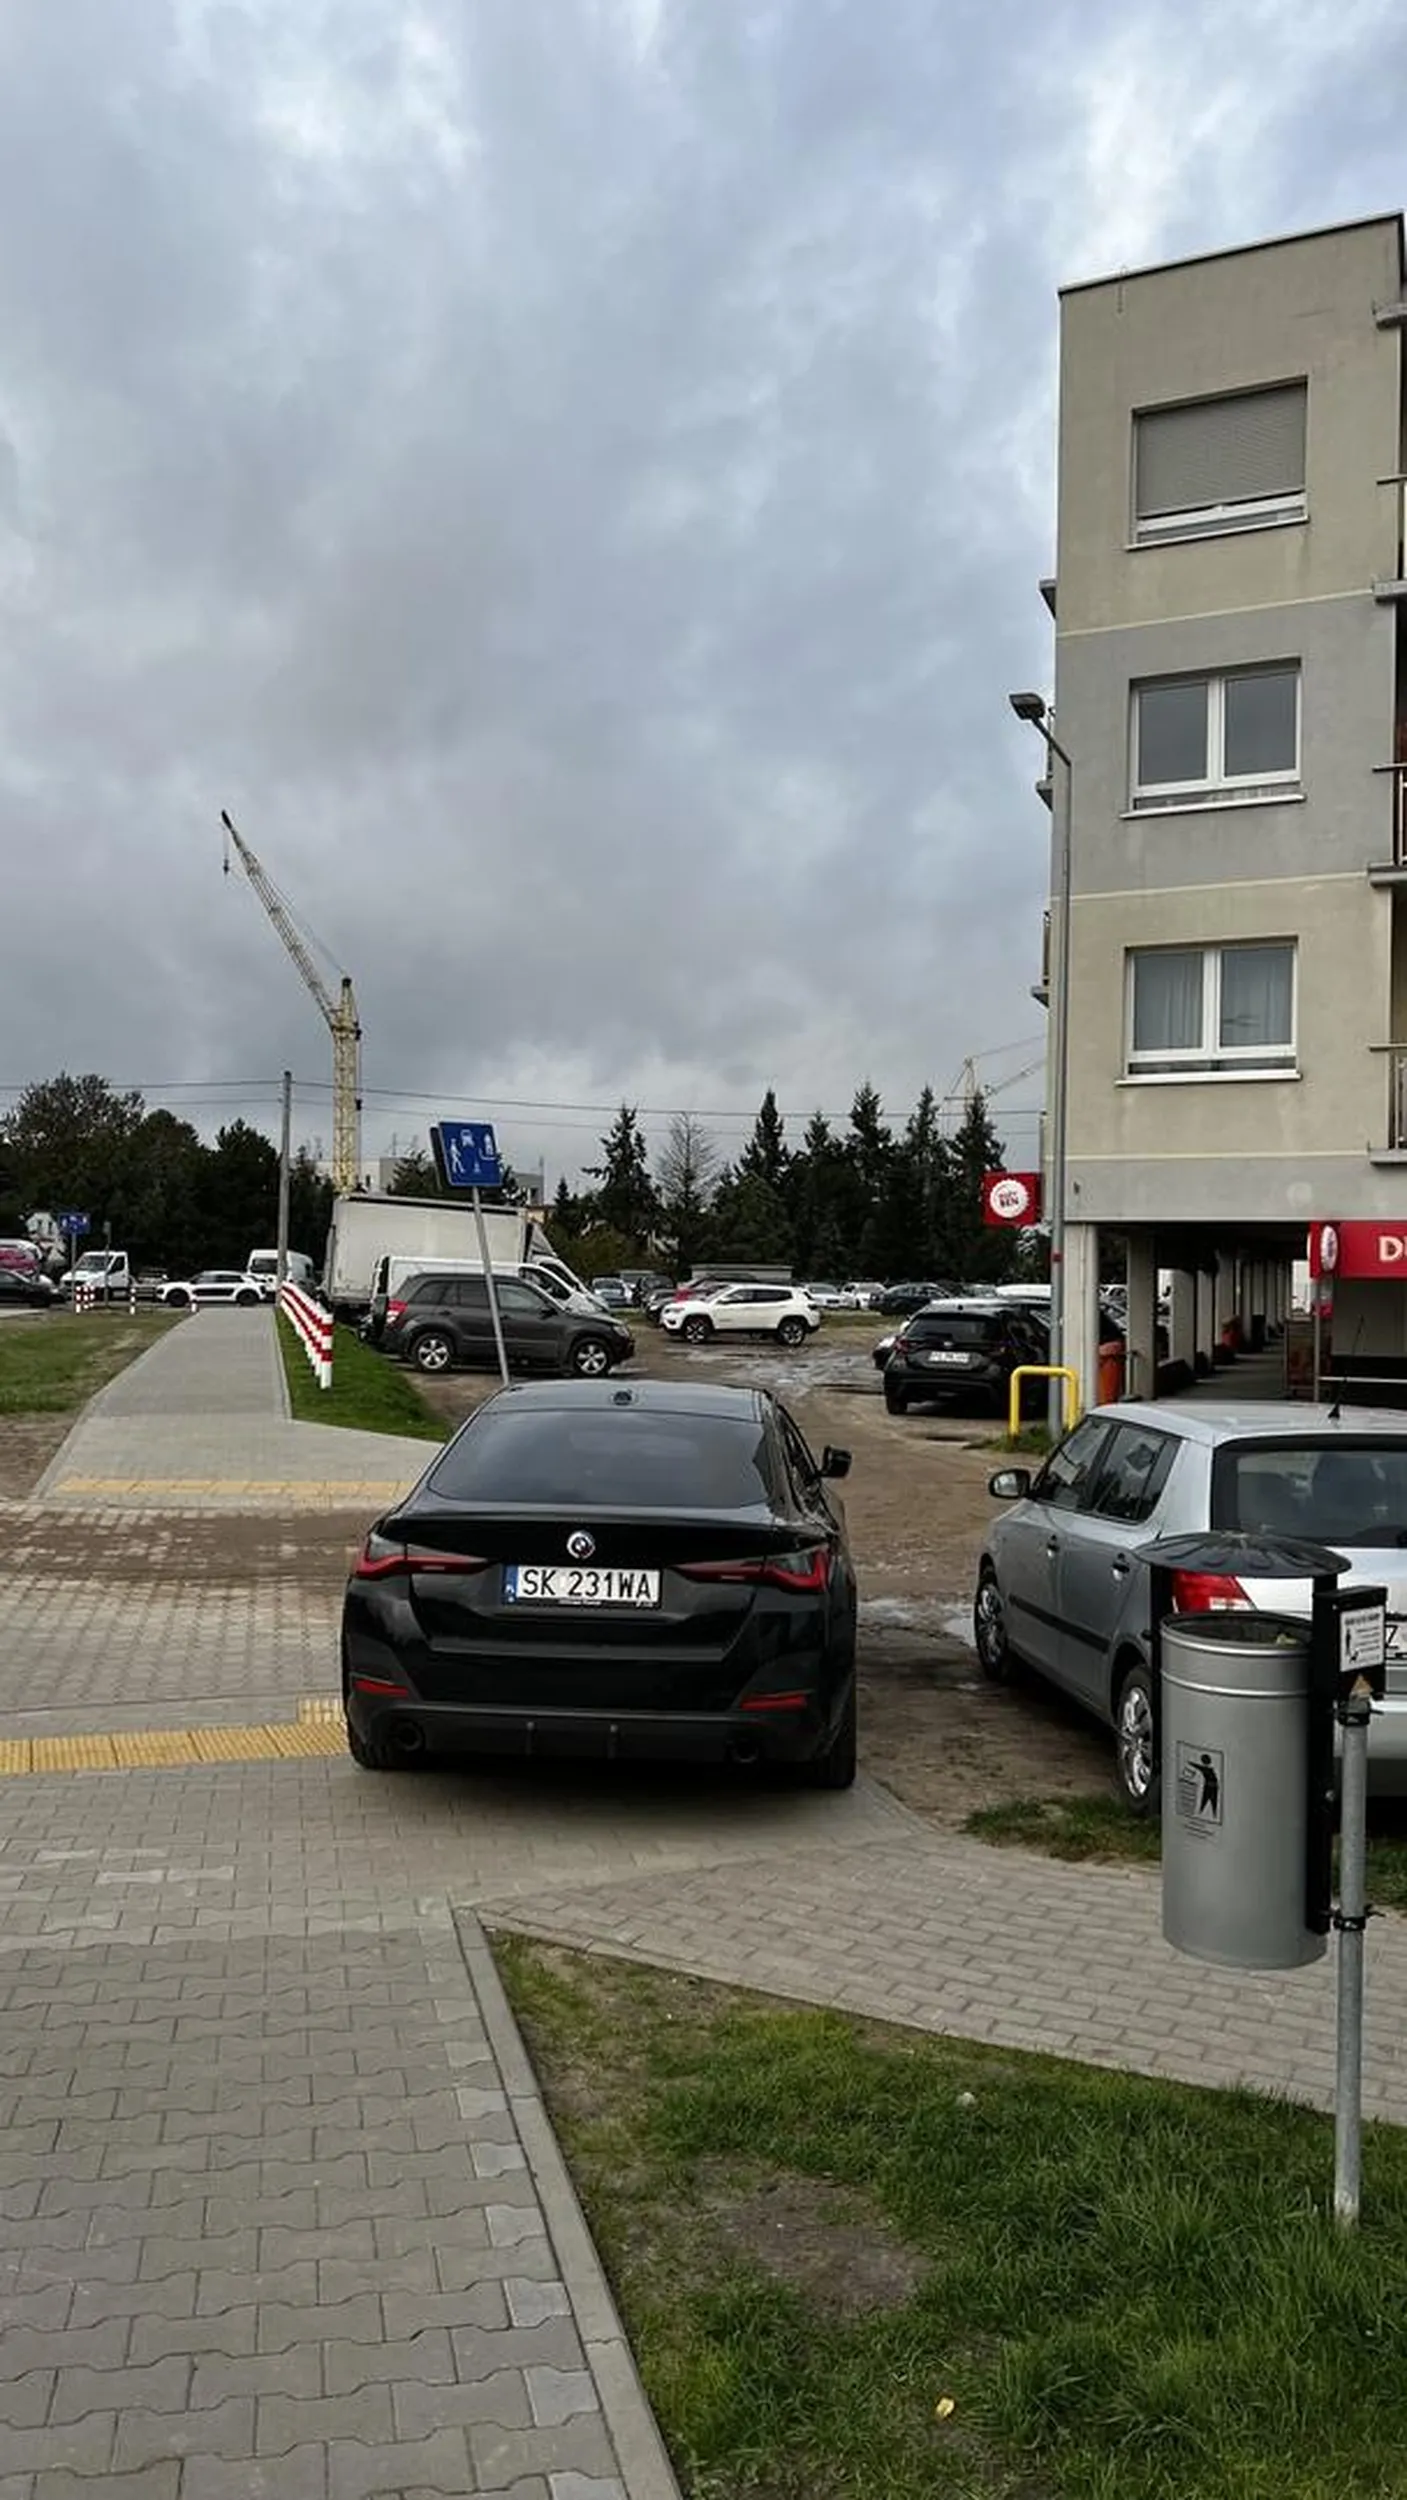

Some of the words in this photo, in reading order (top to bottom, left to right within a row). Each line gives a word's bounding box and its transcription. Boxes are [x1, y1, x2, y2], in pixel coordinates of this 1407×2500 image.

[1379, 1235, 1407, 1263] D
[523, 1569, 556, 1596] SK
[568, 1571, 651, 1599] 231WA
